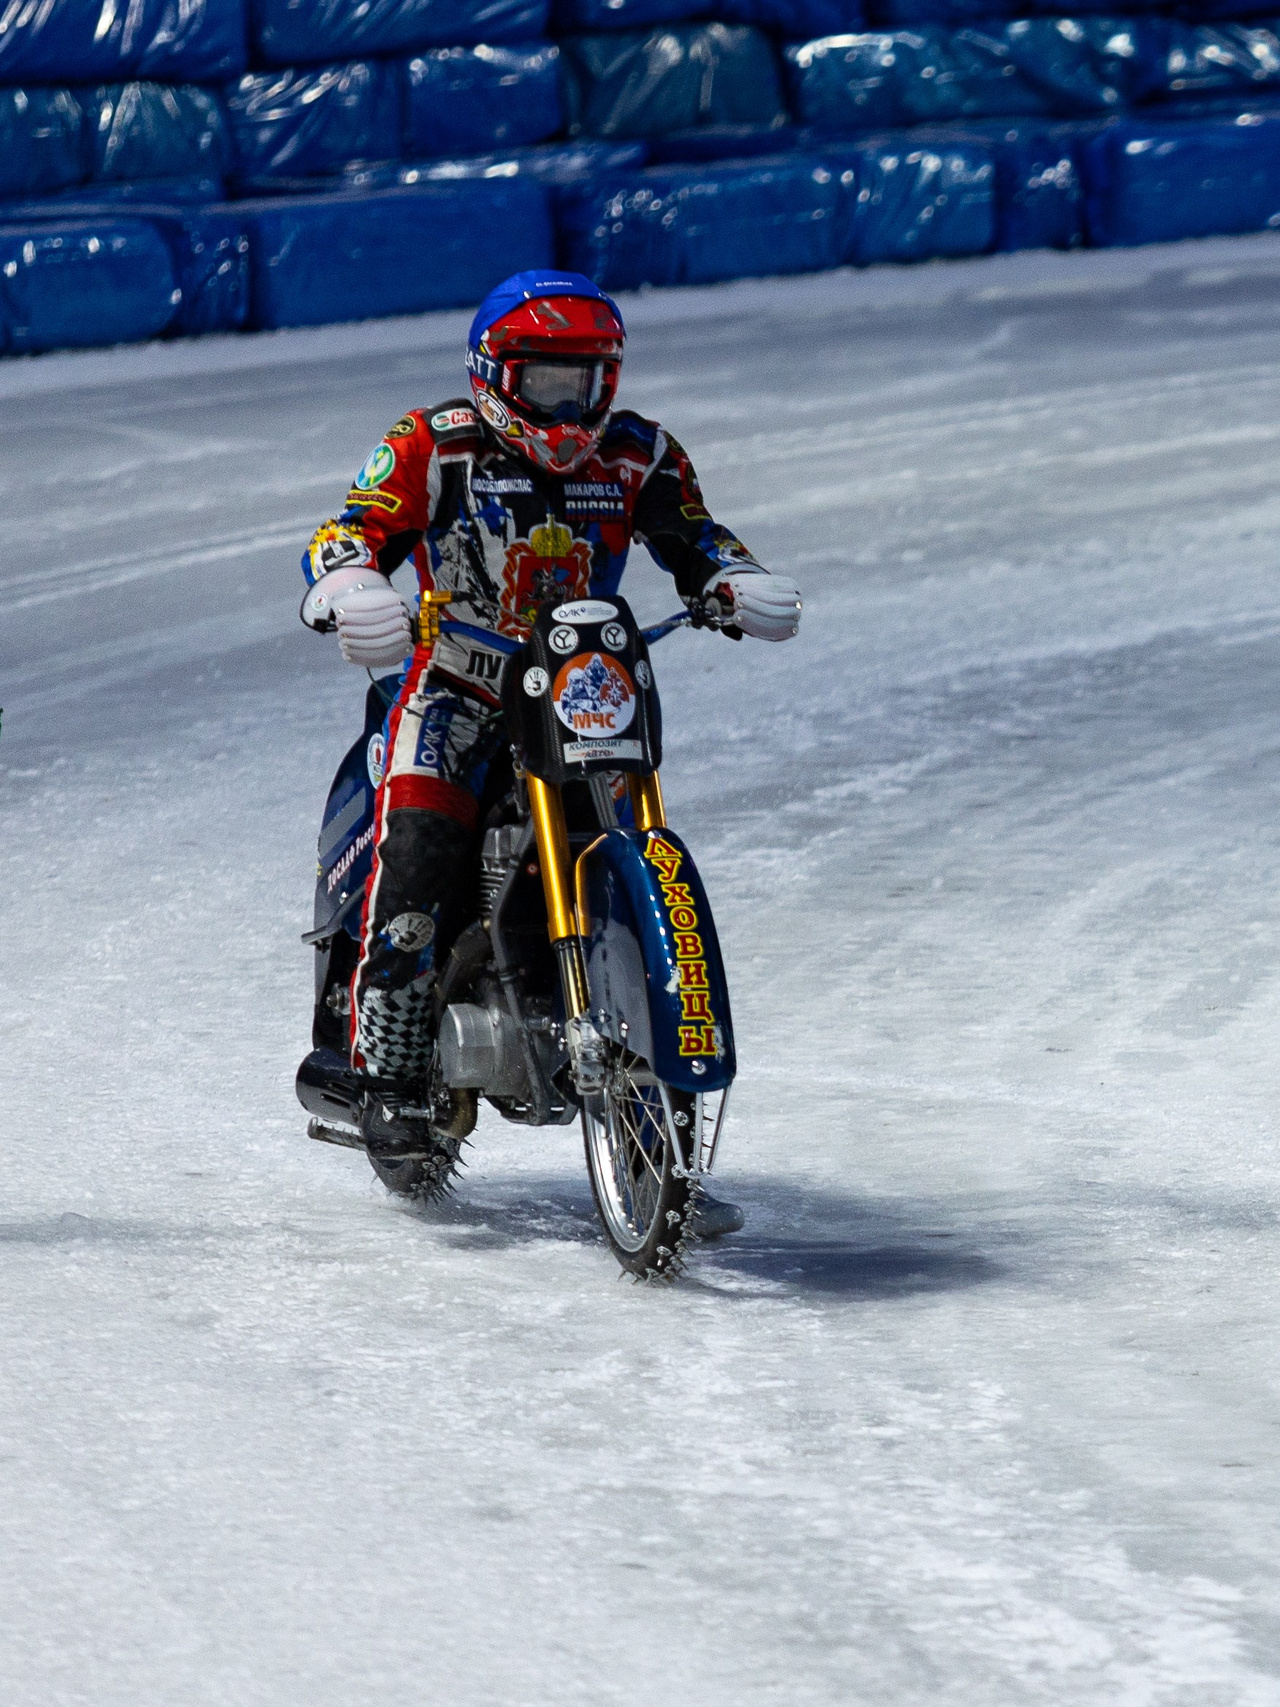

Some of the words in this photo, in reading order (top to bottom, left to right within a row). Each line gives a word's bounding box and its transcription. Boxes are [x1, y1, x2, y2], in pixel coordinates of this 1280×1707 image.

[451, 411, 476, 425] Cas
[564, 483, 604, 497] МАКАРОВ
[565, 501, 624, 521] RUSSIA
[465, 649, 503, 680] ЛУ
[573, 712, 616, 729] МЧС
[569, 739, 623, 751] КОМПОЗИТ
[644, 837, 718, 1056] ЛУХОВИЦЫ
